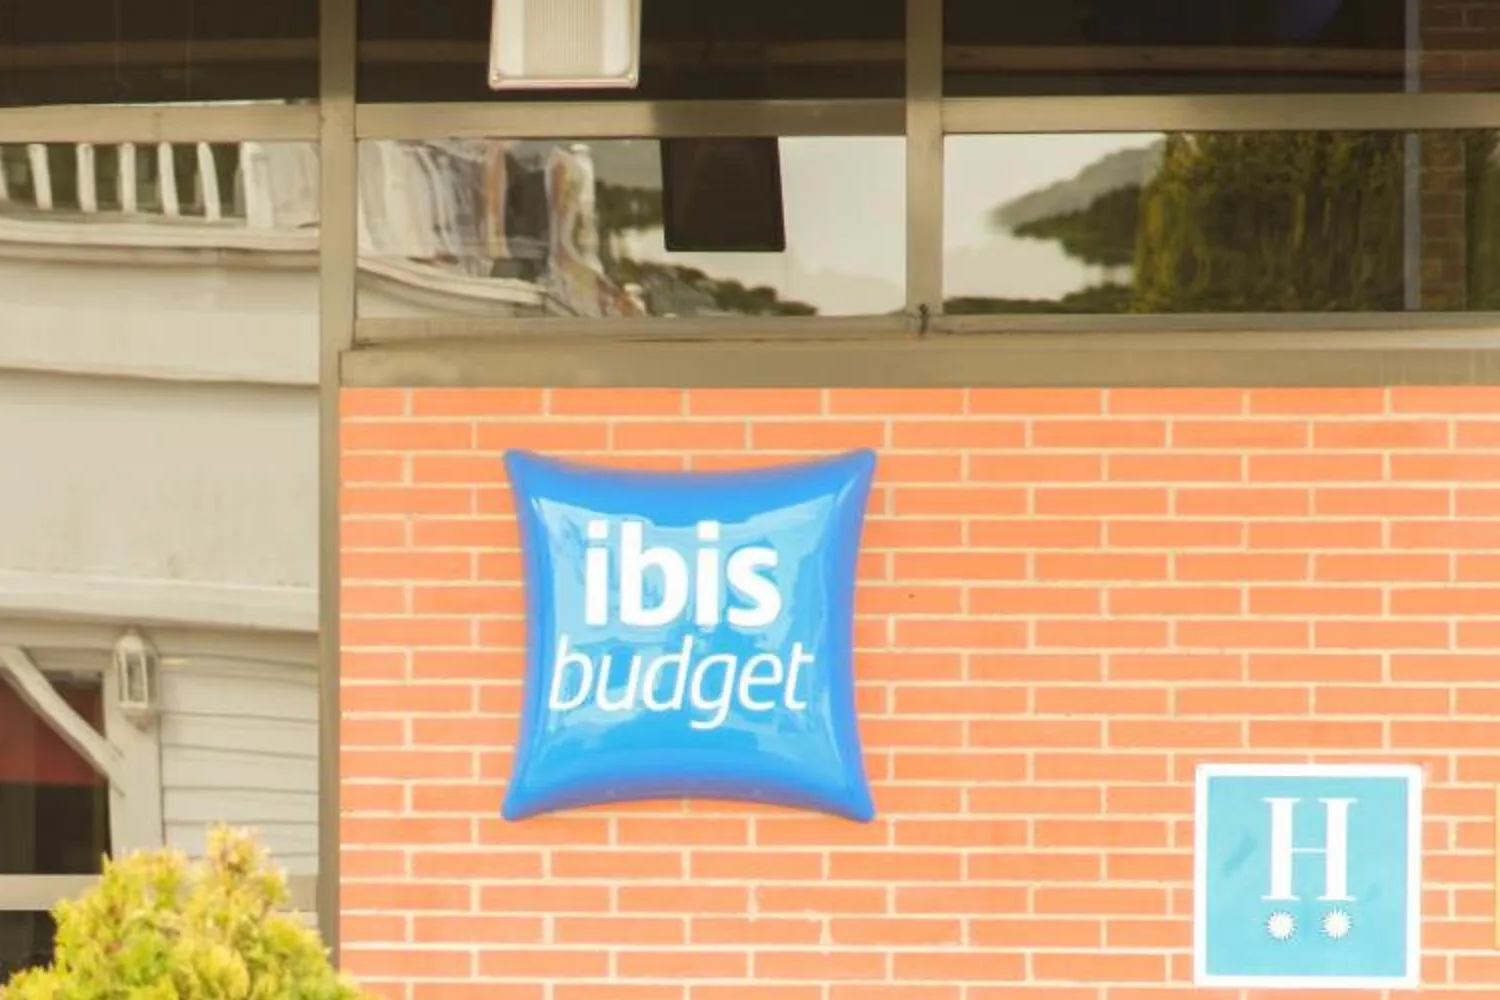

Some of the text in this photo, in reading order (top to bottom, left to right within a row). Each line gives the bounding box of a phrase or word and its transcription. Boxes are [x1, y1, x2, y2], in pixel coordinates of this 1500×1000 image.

[585, 520, 782, 627] ibis
[549, 634, 815, 730] budget
[1260, 797, 1358, 901] H
